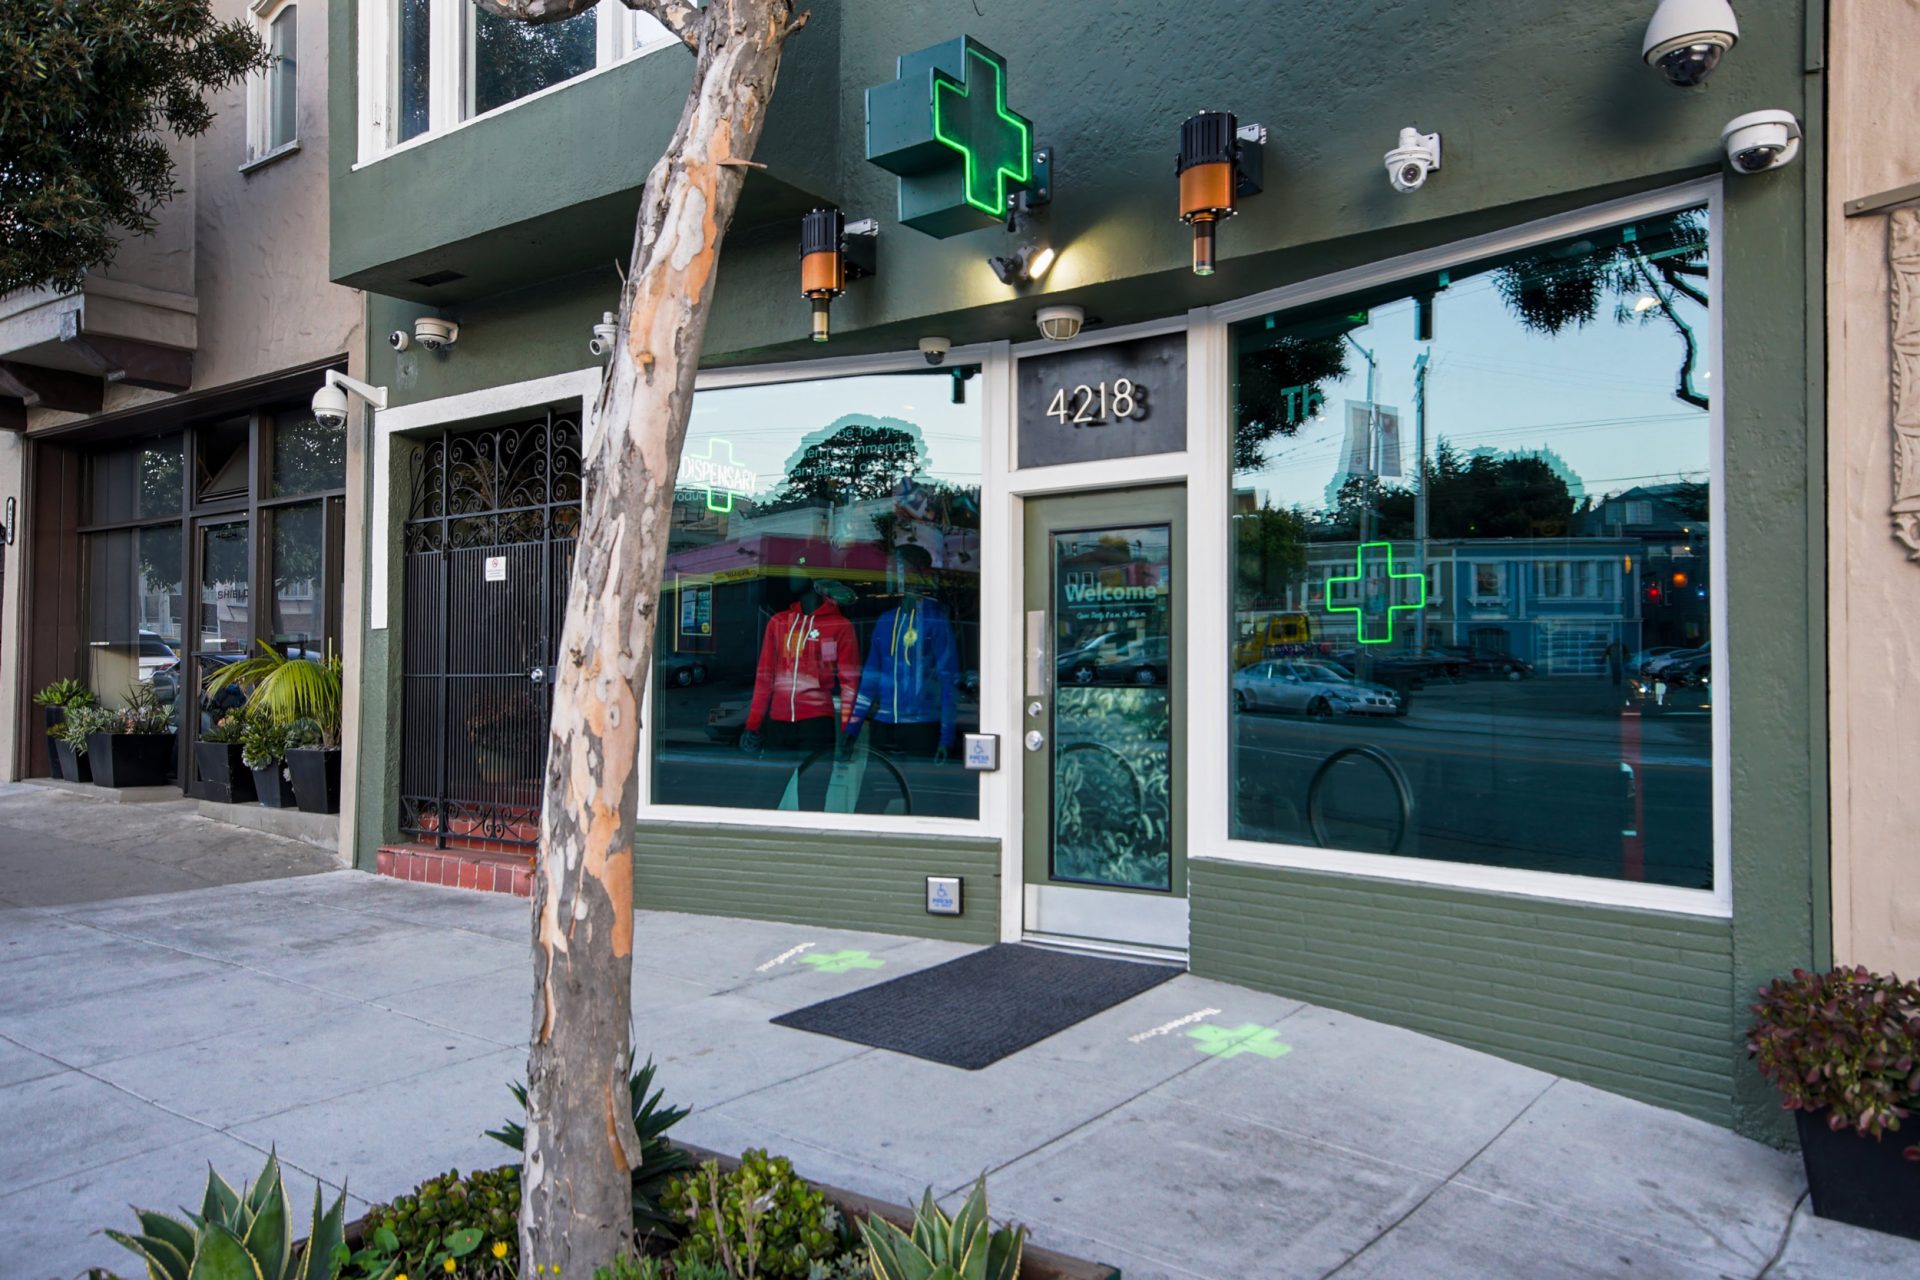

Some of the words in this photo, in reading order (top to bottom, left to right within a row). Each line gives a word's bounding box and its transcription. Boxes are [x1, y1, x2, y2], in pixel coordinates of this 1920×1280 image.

[1046, 378, 1134, 425] 4218
[681, 457, 757, 494] DISPENSARY
[1064, 581, 1157, 603] Welcome
